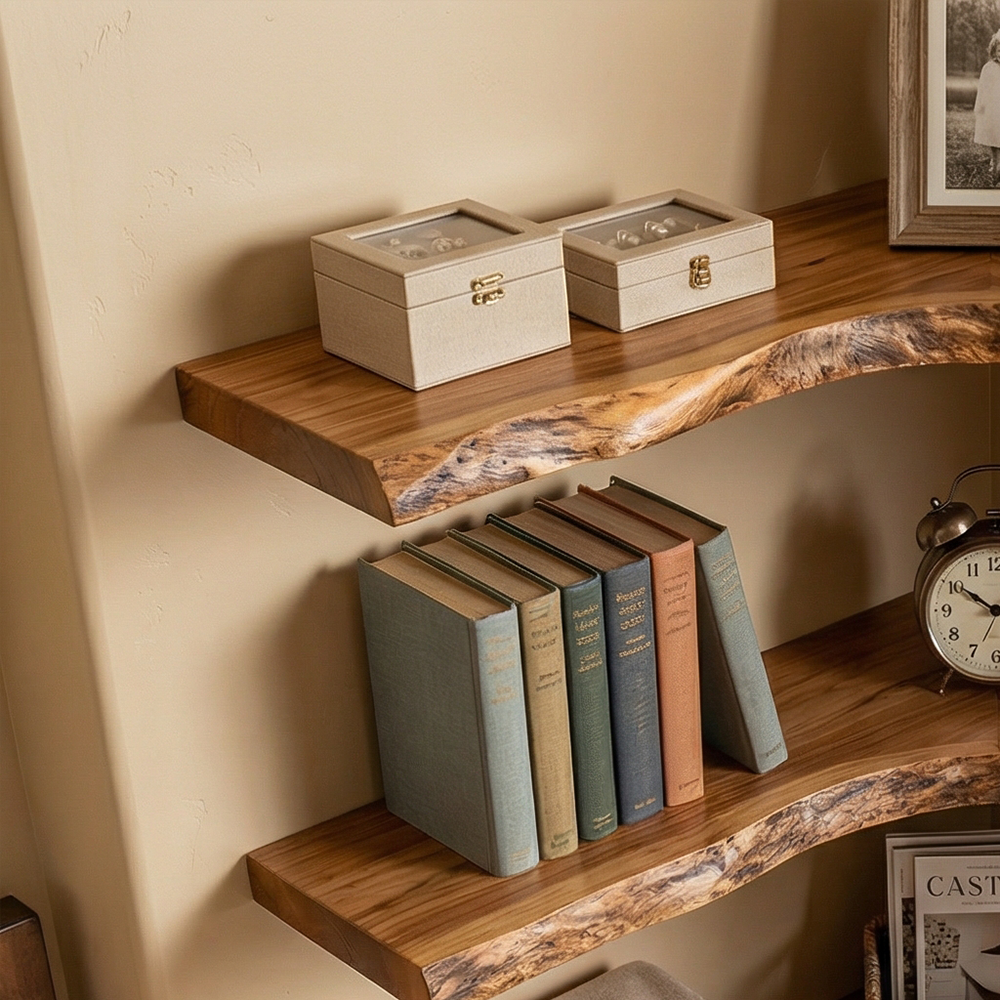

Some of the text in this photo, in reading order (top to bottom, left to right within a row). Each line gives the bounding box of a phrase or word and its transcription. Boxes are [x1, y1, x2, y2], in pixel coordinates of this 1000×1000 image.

[967, 563, 979, 577] 11
[948, 580, 964, 594] 10
[941, 604, 952, 618] 9
[949, 627, 960, 641] 8
[969, 644, 978, 658] 7
